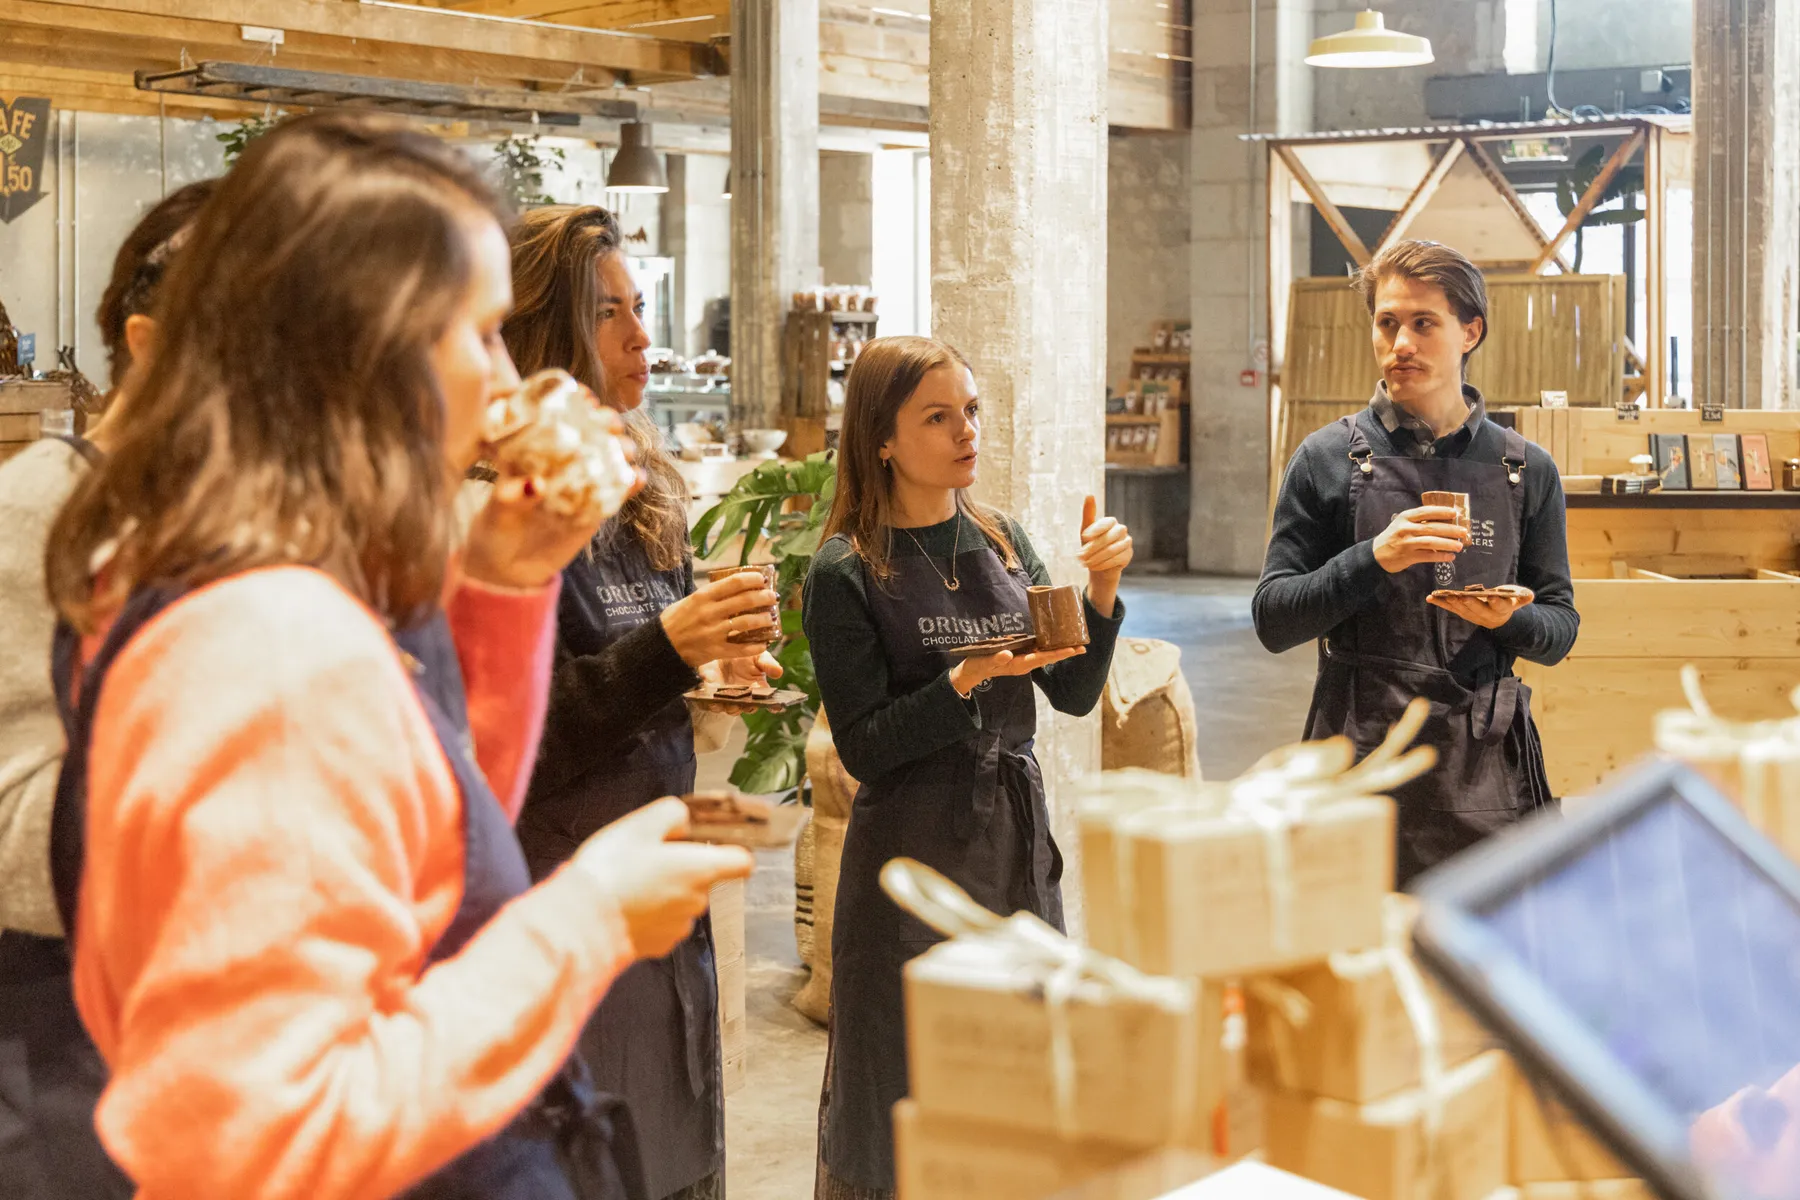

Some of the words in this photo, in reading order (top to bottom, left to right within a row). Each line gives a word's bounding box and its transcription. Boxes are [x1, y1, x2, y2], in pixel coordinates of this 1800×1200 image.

[0, 107, 37, 141] AFE
[605, 602, 656, 617] CHOCOLATE
[917, 612, 1025, 635] ORIGINES
[922, 635, 979, 646] CHOCOLATE
